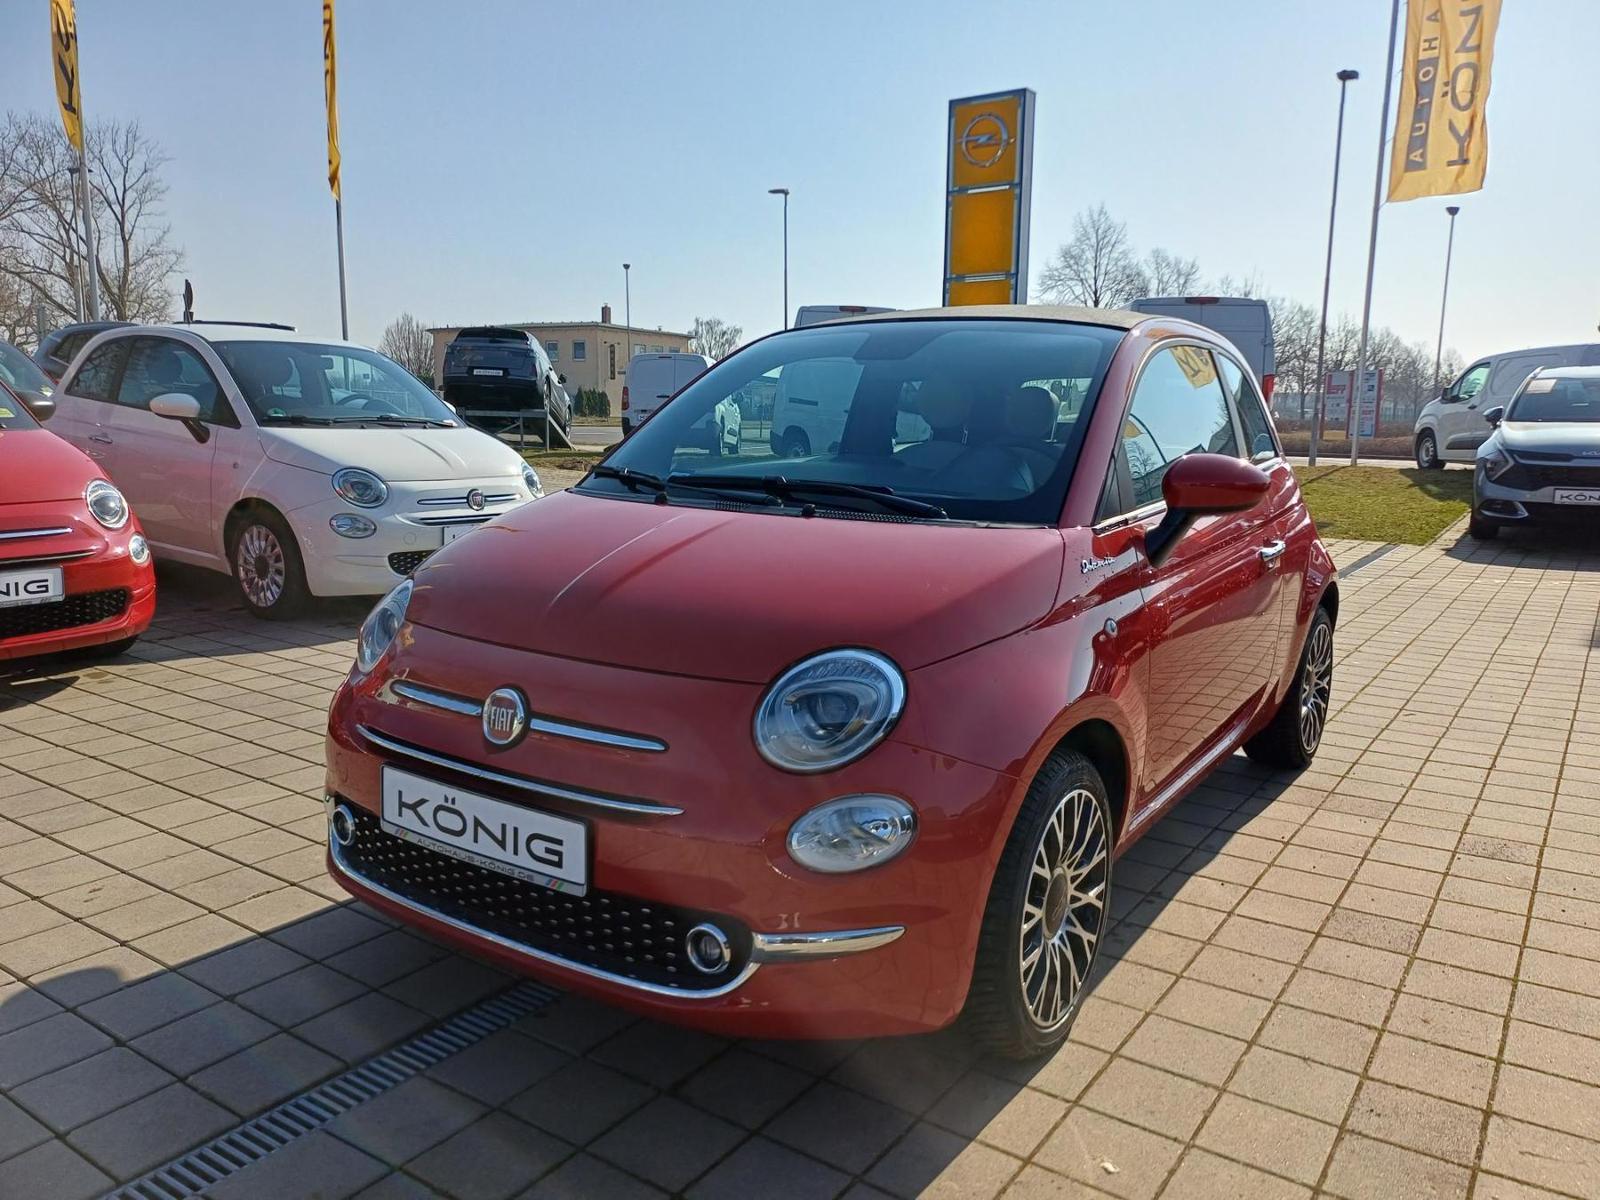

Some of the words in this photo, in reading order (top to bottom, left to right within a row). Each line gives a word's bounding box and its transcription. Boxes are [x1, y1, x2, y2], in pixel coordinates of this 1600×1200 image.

[1441, 0, 1483, 167] KÖN
[490, 706, 514, 731] FIAT
[398, 790, 563, 869] KÖNIG
